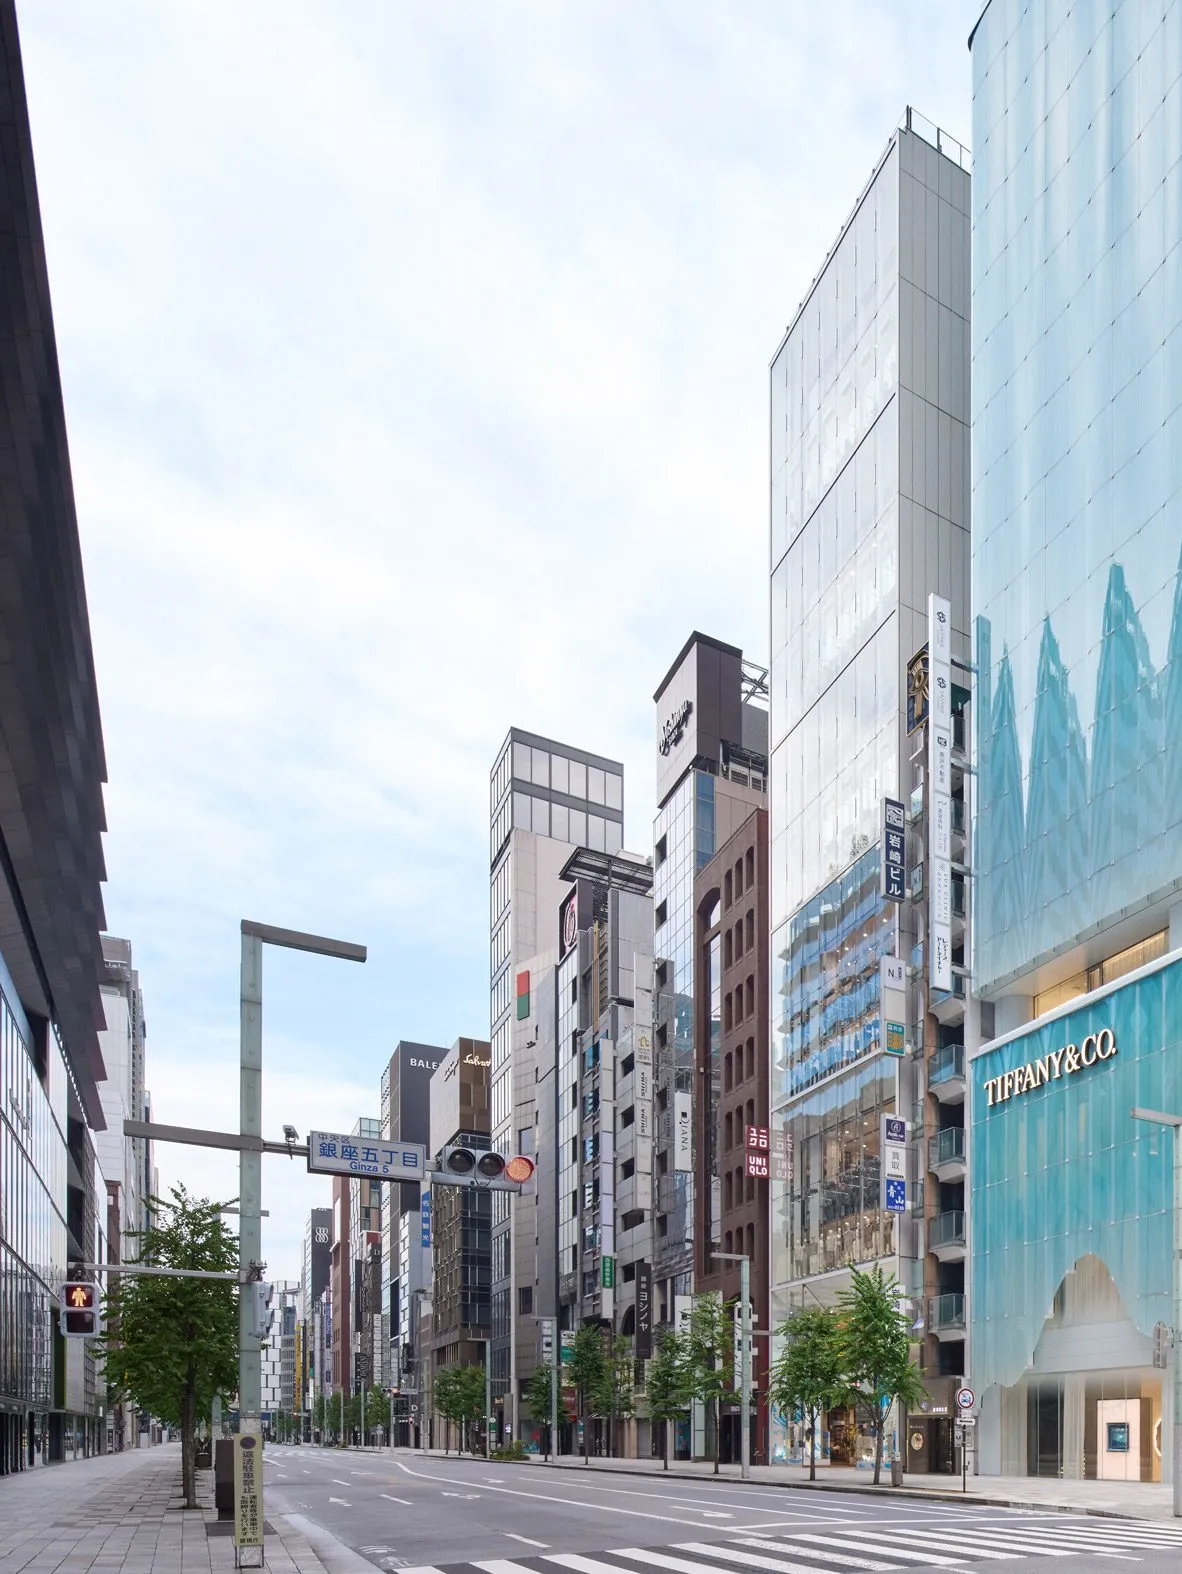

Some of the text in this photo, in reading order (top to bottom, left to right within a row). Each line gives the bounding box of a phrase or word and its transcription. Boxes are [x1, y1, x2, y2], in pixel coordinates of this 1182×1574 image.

[889, 833, 901, 896] 岩崎ビル
[410, 1058, 440, 1070] BALE
[318, 1133, 350, 1143] 中央区
[680, 1118, 690, 1151] DIANA
[319, 1142, 418, 1168] 銀座五丁目
[749, 1155, 766, 1166] UNI
[350, 1161, 389, 1174] Ginza 5
[749, 1165, 768, 1176] QLO
[242, 1451, 254, 1493] 違法駐車禁止
